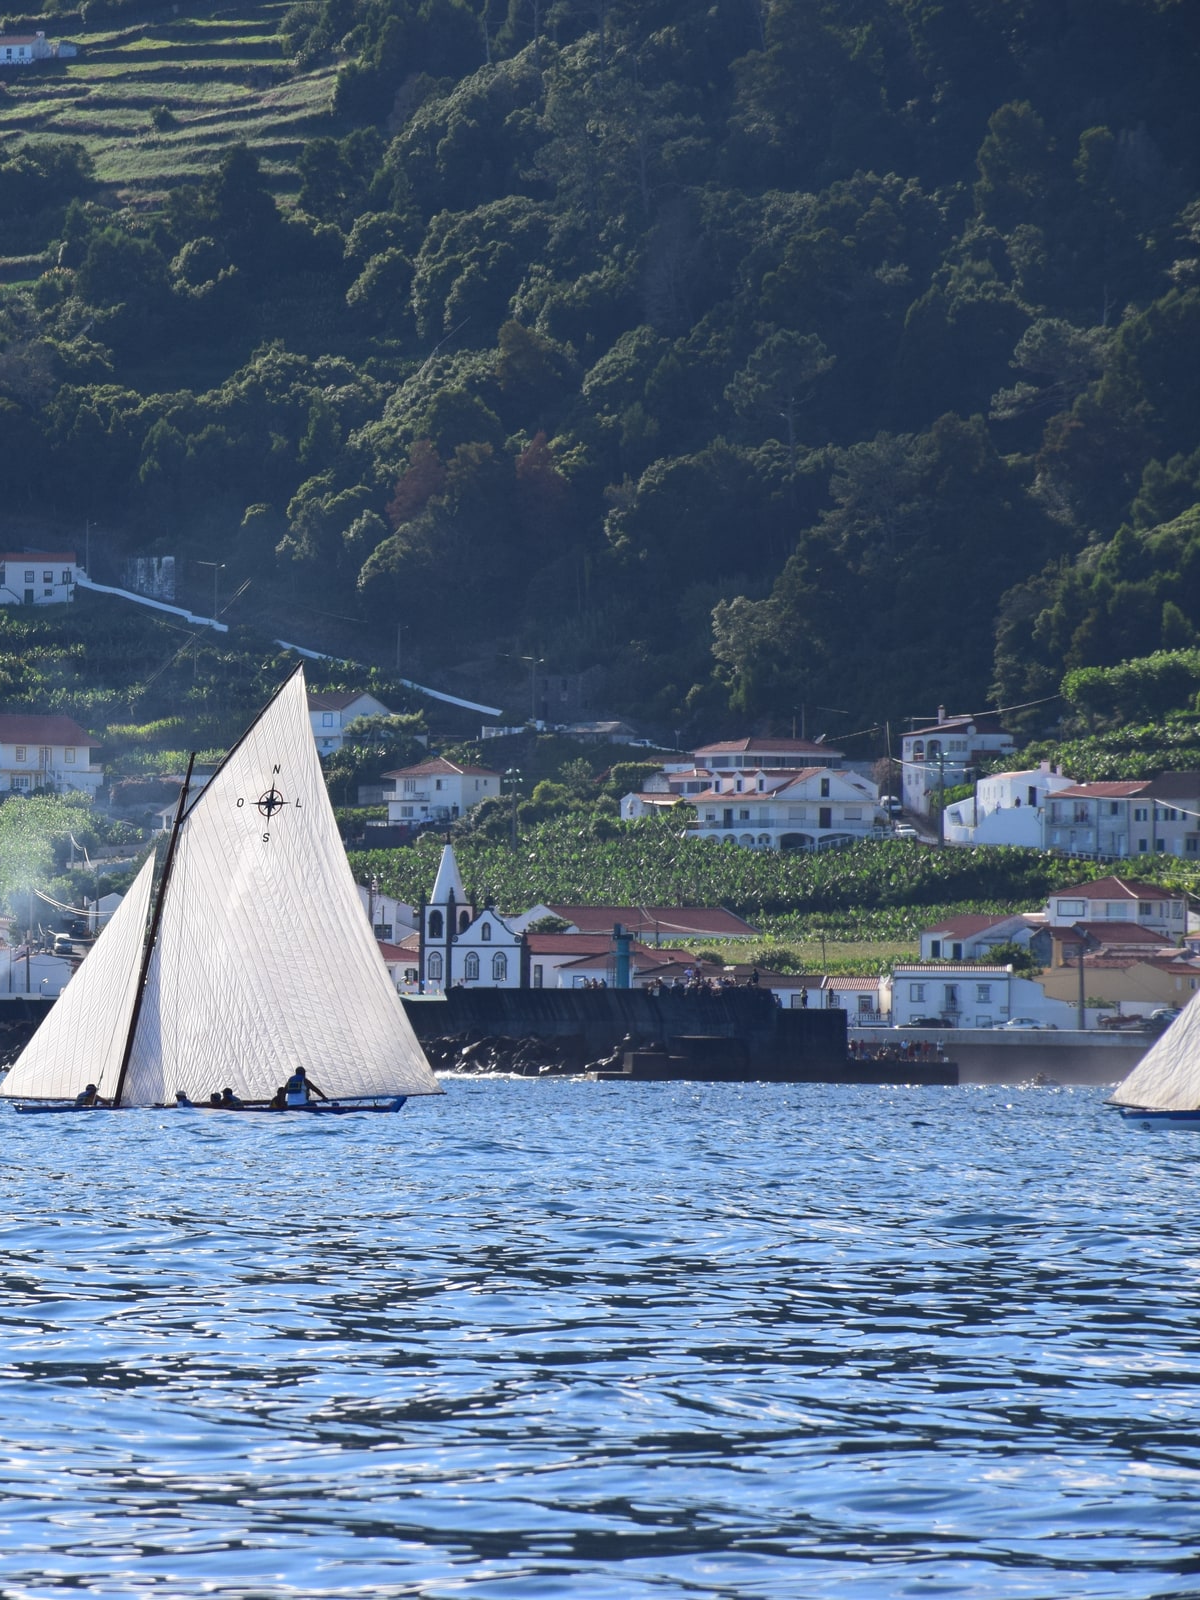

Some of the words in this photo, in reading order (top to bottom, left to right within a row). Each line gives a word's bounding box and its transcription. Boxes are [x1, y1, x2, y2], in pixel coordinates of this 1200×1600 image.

[272, 764, 281, 774] N
[236, 798, 245, 808] O
[295, 798, 303, 808] L
[262, 832, 271, 843] S
